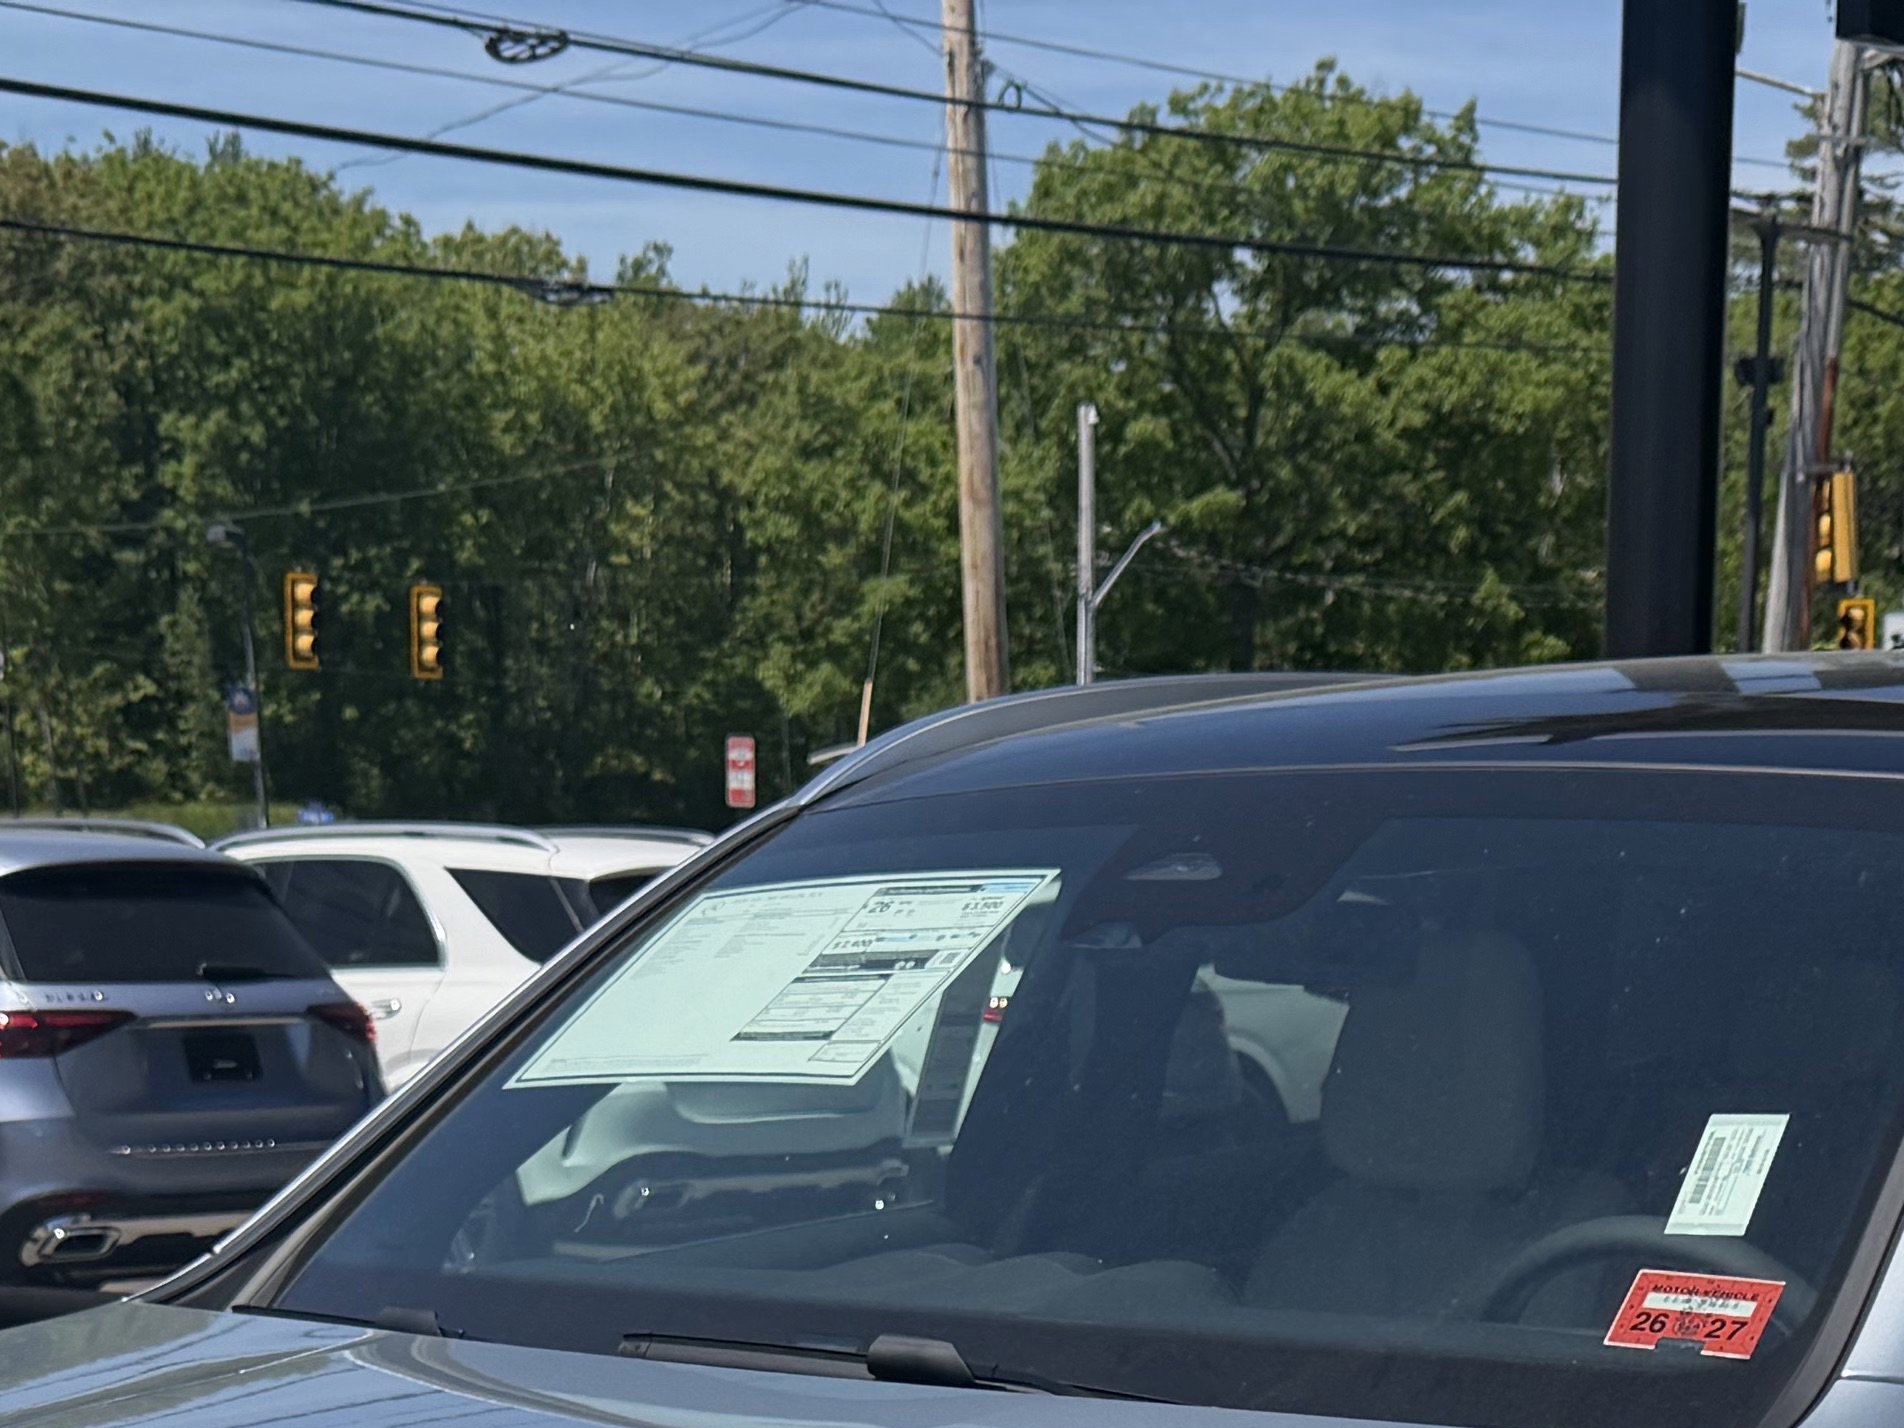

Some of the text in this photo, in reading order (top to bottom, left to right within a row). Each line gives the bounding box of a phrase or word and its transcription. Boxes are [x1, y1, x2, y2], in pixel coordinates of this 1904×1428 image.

[1651, 1284, 1698, 1298] MOTOR
[1629, 1311, 1748, 1341] 26 27
